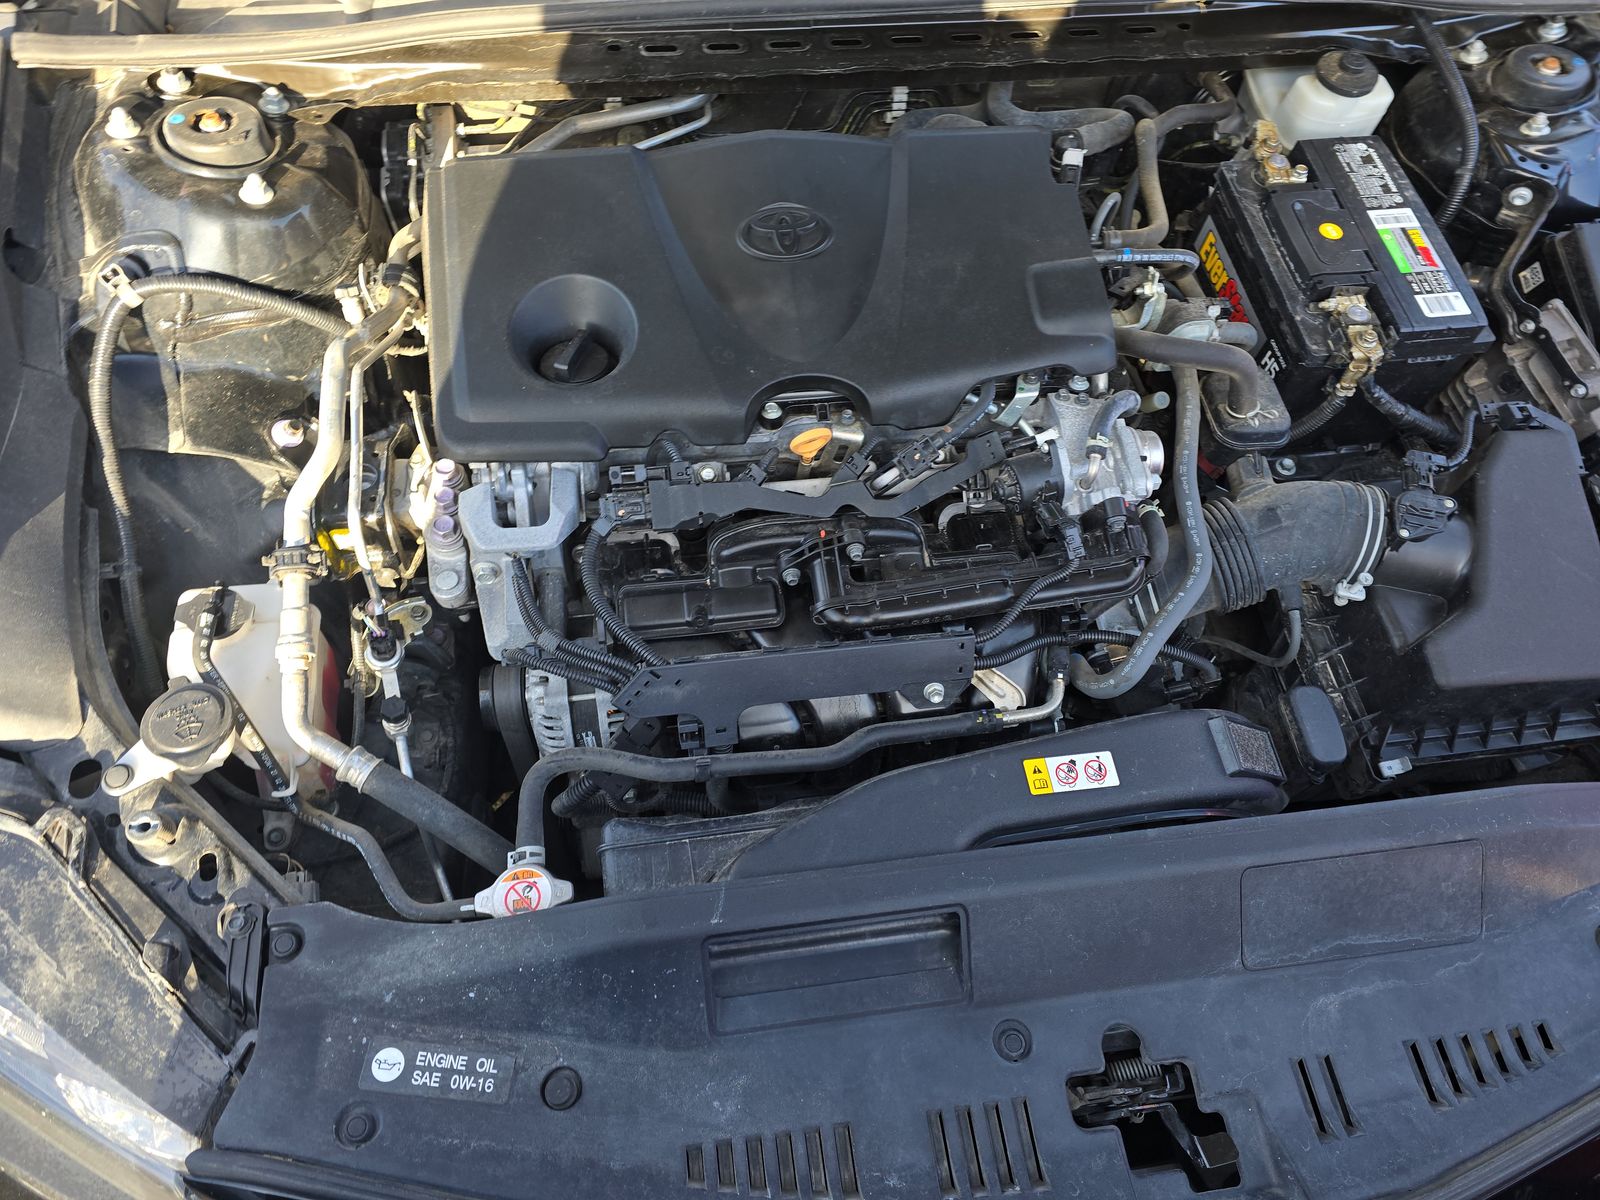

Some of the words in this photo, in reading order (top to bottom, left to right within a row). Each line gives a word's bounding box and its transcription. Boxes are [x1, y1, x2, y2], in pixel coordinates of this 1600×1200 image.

[1261, 351, 1280, 380] H5
[415, 1051, 468, 1071] ENGINE
[475, 1057, 498, 1074] OIL
[411, 1070, 442, 1088] SAE
[450, 1074, 494, 1093] 0W-16
